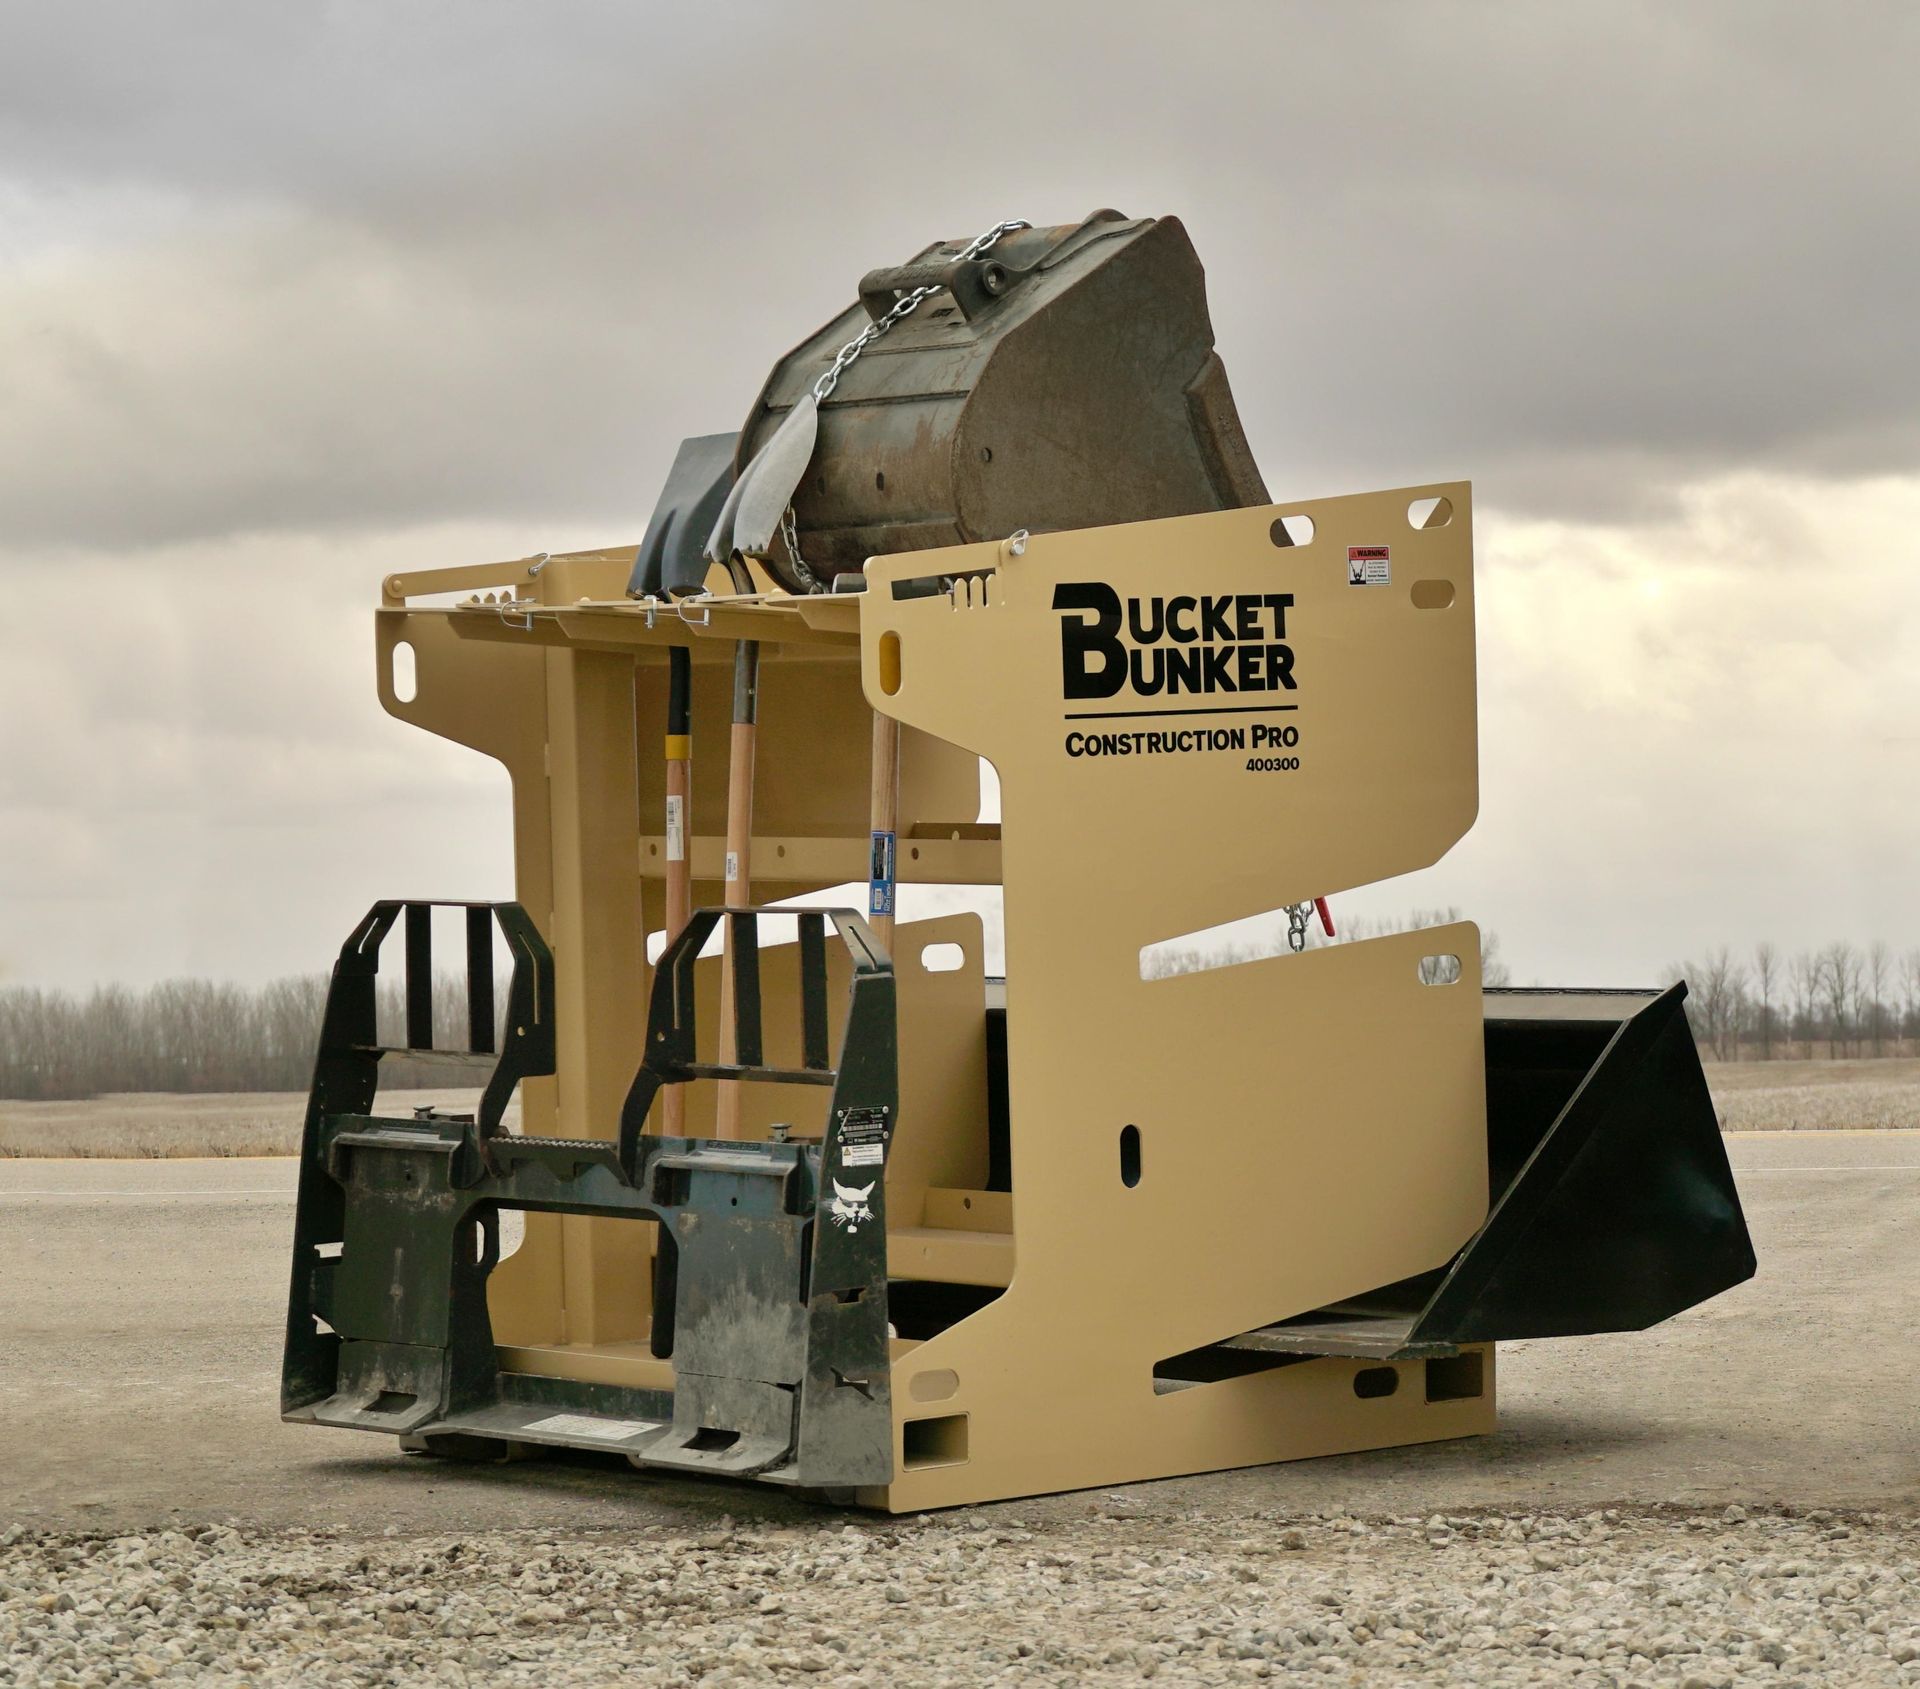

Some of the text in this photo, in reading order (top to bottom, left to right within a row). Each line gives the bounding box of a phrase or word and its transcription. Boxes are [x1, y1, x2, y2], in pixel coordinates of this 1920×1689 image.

[1357, 549, 1386, 558] WARNING
[1052, 582, 1295, 651] BUCKET
[1060, 643, 1298, 699] BUNKER
[1065, 724, 1299, 758] CONSTRUCTION PRO
[1246, 757, 1300, 772] 400300
